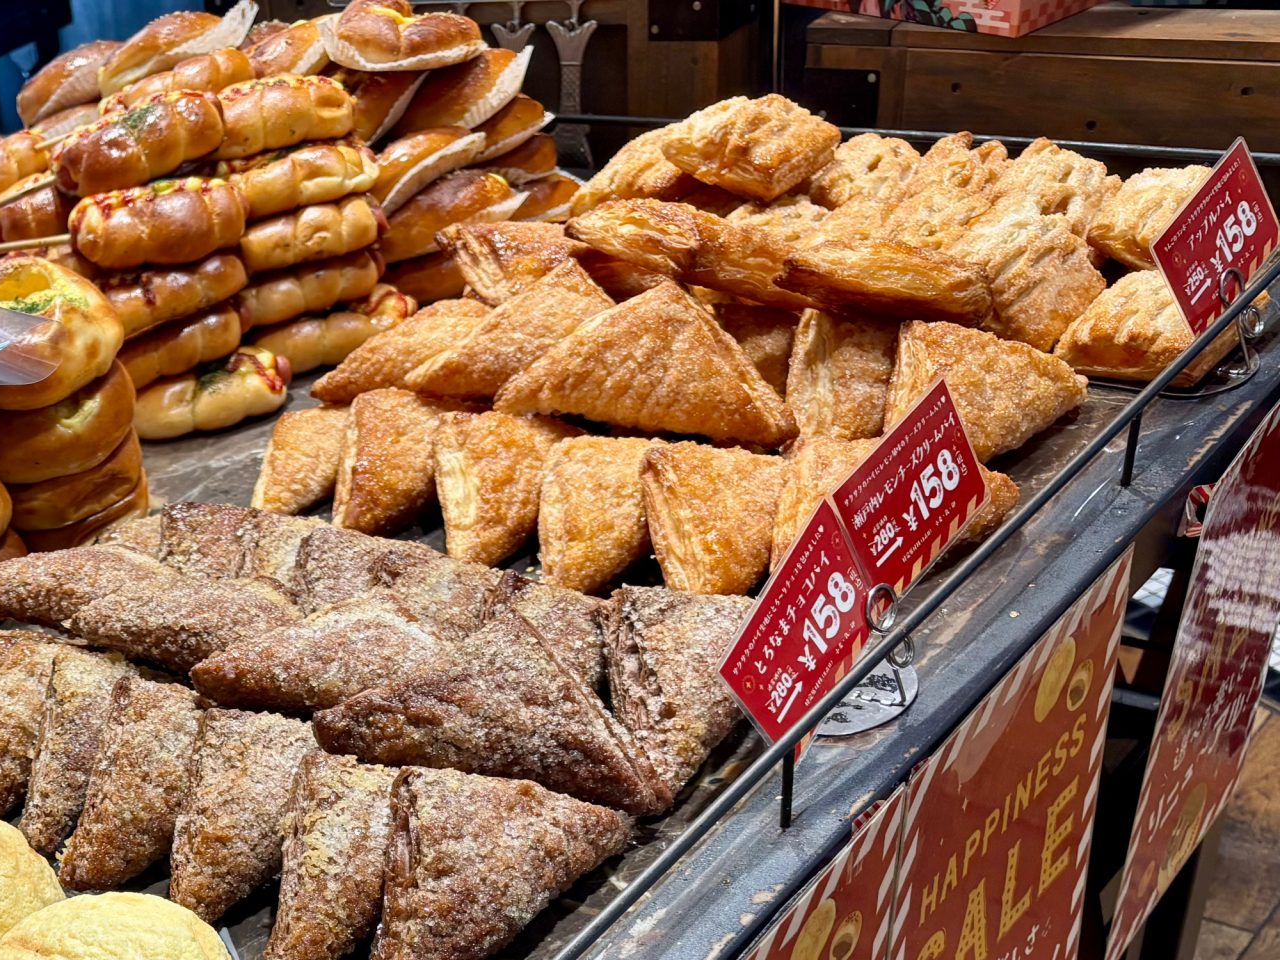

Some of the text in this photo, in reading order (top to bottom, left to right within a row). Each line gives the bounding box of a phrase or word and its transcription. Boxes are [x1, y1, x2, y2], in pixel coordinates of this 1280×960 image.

[1186, 191, 1232, 252] アップルパイ
[1209, 200, 1258, 273] ¥158
[851, 413, 956, 530] 瀬戸内レモンチーズクリームパイ
[902, 449, 961, 532] ¥158
[754, 550, 831, 675] とろなまチョコパイ
[797, 571, 856, 673] ¥158
[921, 713, 1087, 927] HAPPINESS
